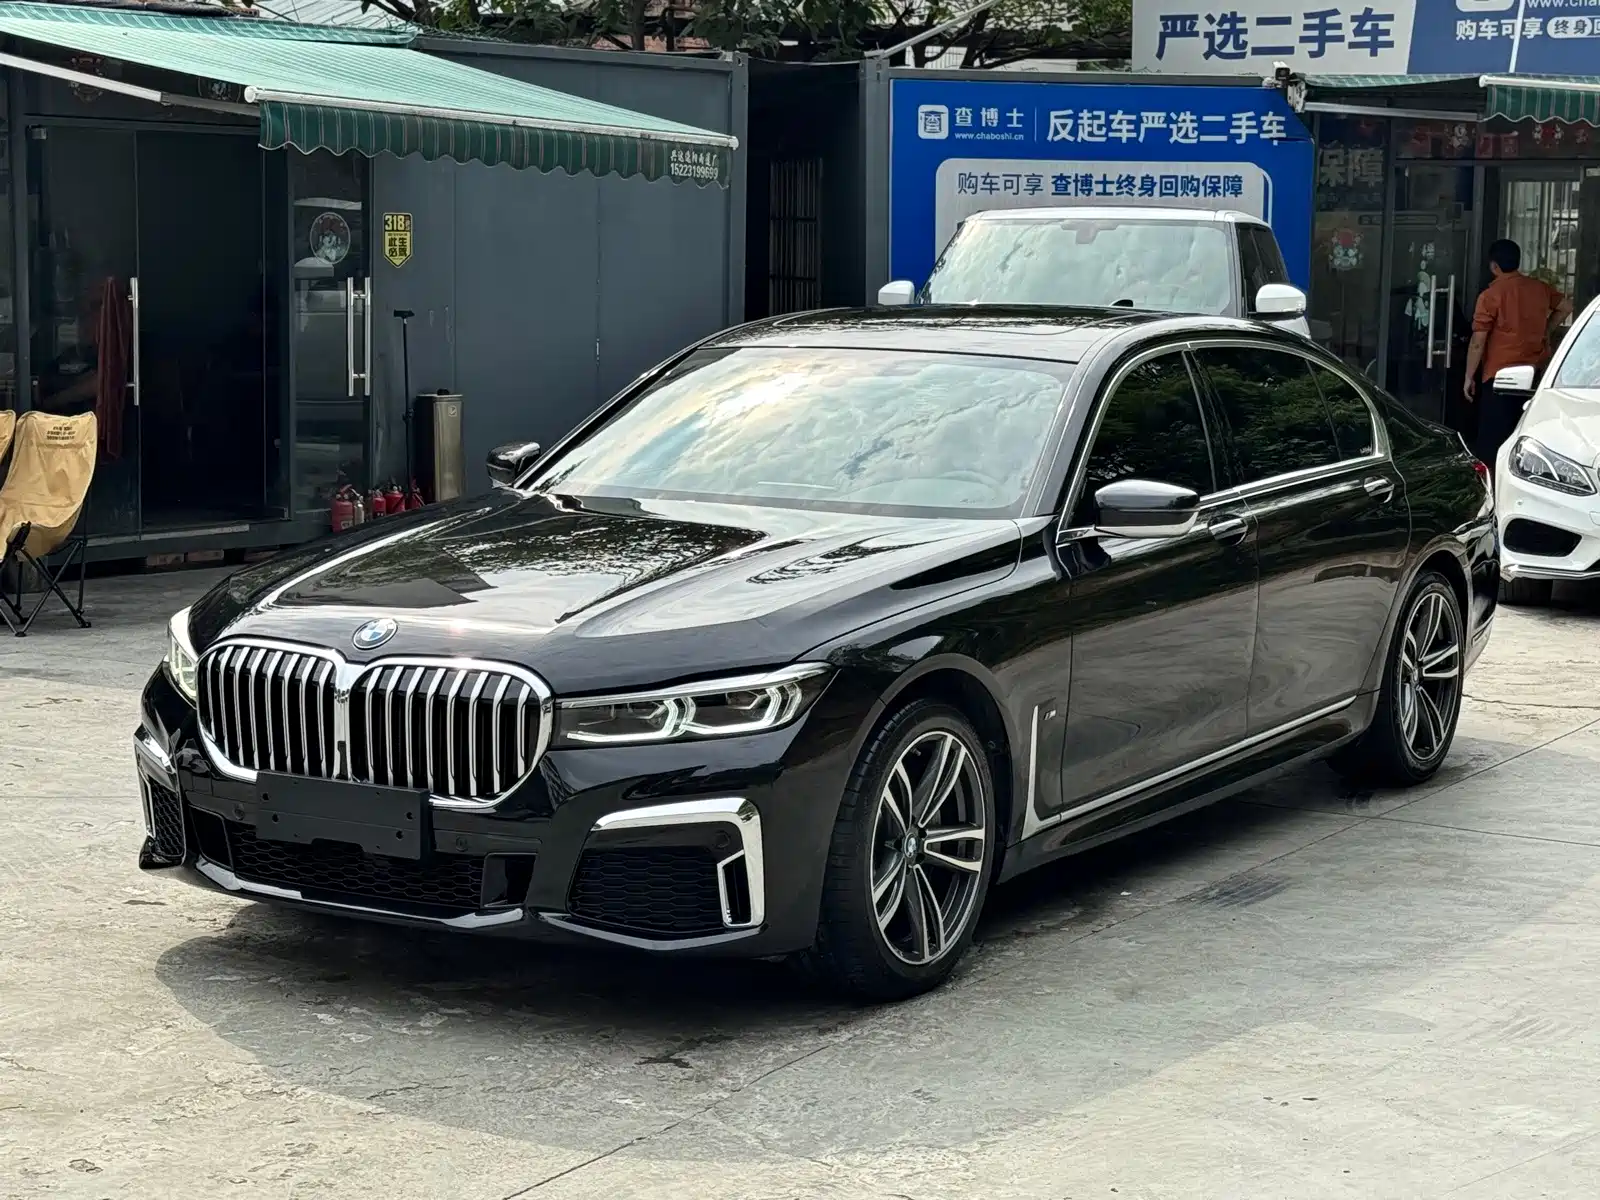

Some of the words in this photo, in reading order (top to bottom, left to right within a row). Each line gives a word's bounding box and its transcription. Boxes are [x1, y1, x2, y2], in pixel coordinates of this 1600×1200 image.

[1155, 7, 1395, 61] 严选二手车
[1455, 17, 1543, 41] 购车可享
[955, 107, 1024, 127] 查博士
[1047, 109, 1287, 146] 反起车严选二手车
[955, 132, 1024, 141] www.chaboshi.cn
[957, 173, 1044, 196] 购车可享
[1051, 174, 1243, 198] 查博士终身回购保障
[385, 215, 405, 231] 318
